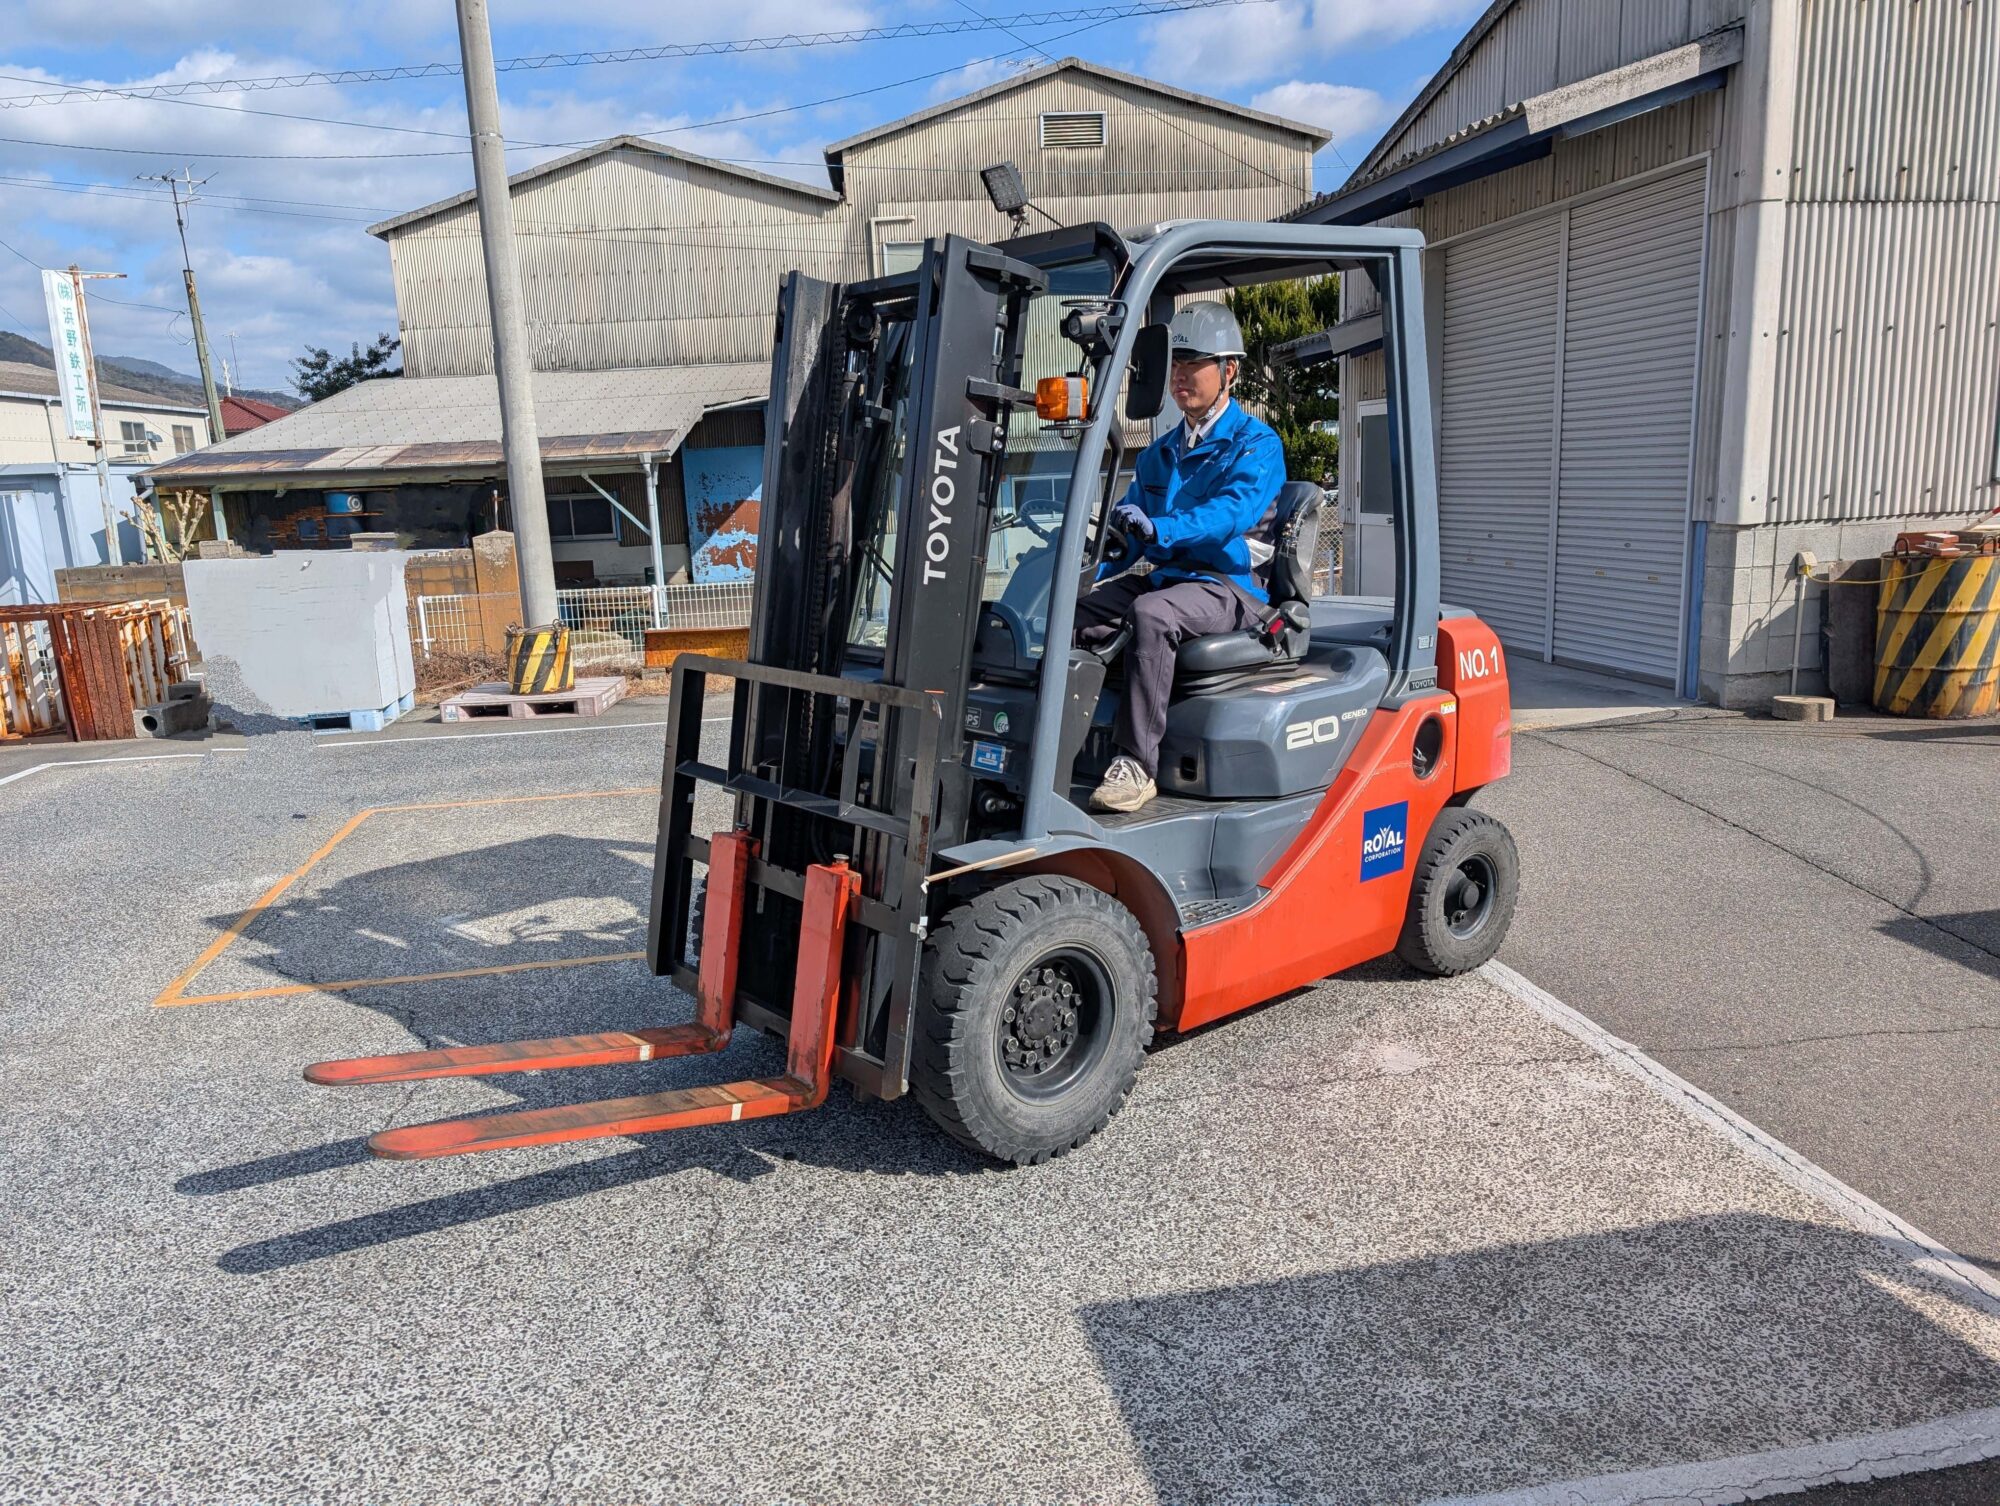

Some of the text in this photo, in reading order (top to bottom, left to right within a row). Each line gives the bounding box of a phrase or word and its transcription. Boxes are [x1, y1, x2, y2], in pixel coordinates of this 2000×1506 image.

[1172, 333, 1189, 343] OYAL
[923, 425, 961, 585] TOYOTA
[1411, 678, 1435, 690] TOYOTA
[1341, 708, 1368, 721] GENEO
[1286, 715, 1339, 750] 20
[1363, 824, 1404, 855] ROYAL
[1364, 846, 1402, 863] CORPORATION
